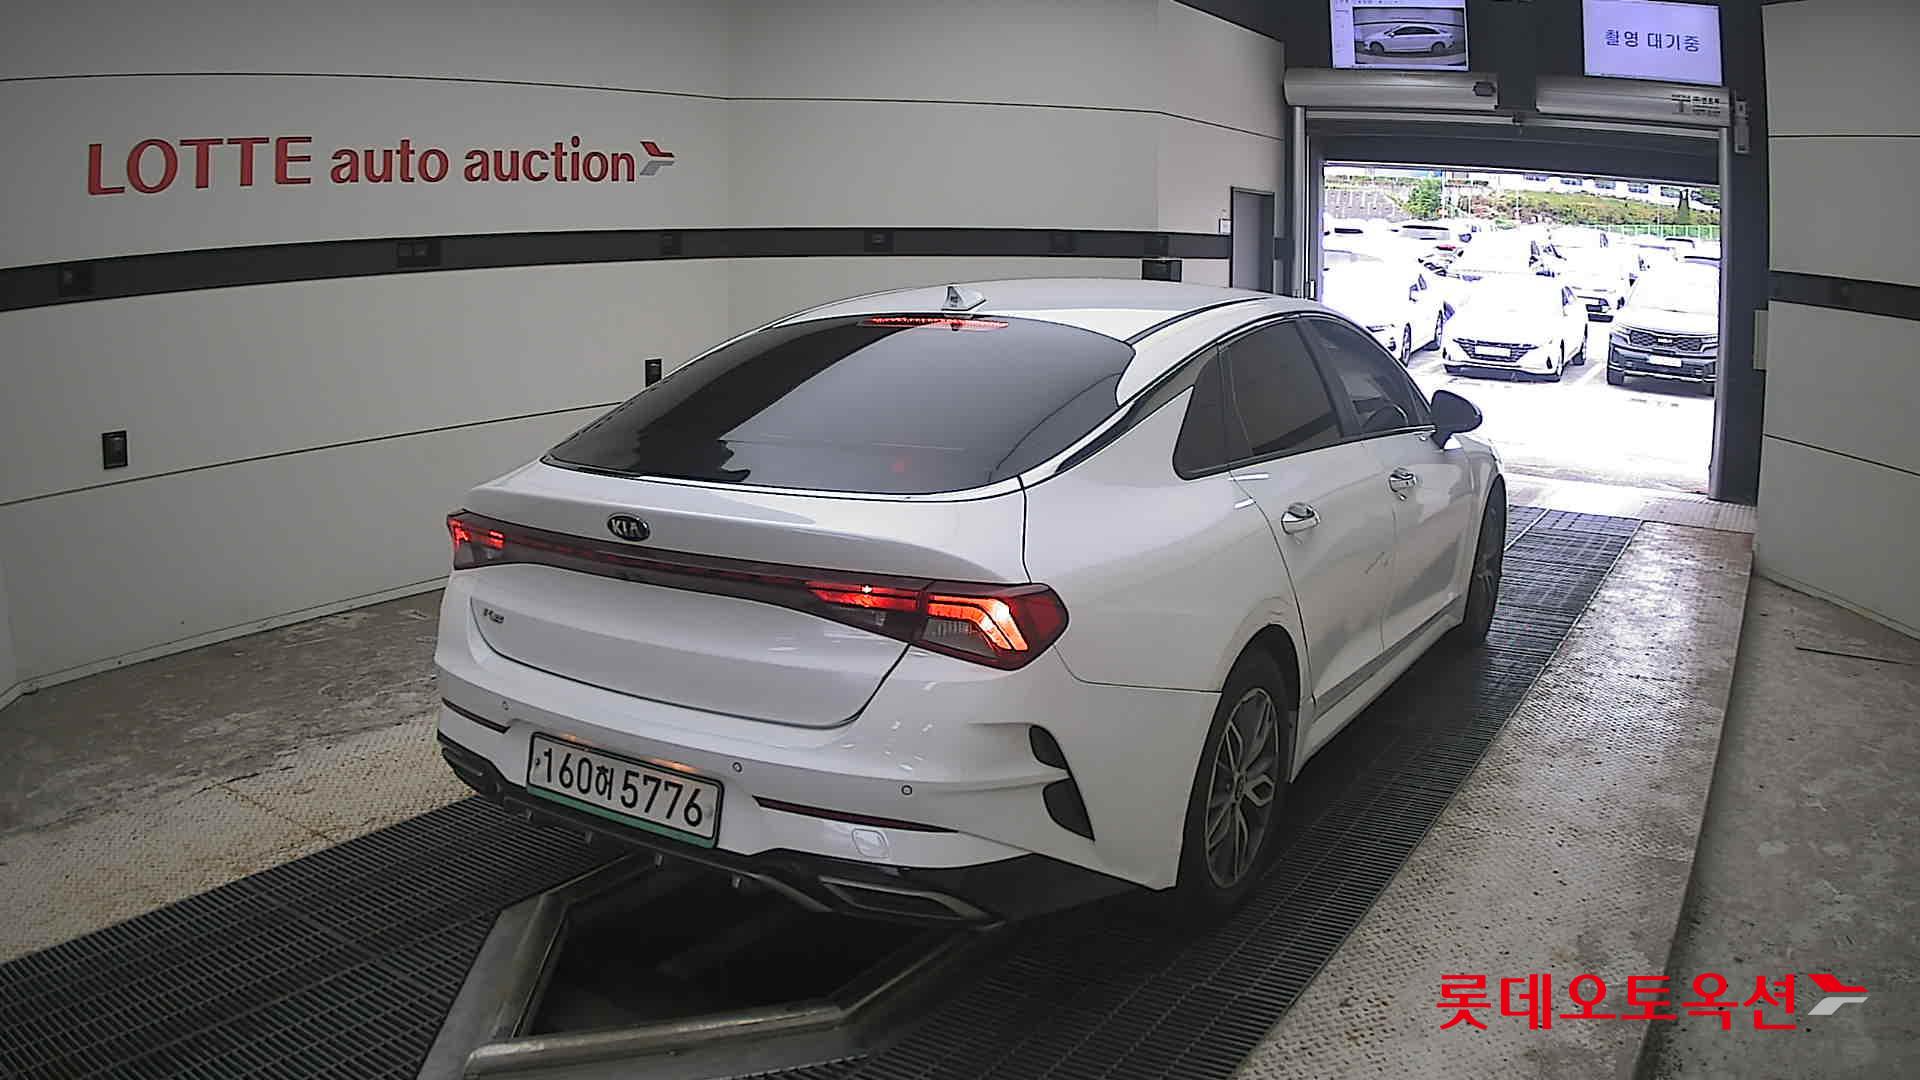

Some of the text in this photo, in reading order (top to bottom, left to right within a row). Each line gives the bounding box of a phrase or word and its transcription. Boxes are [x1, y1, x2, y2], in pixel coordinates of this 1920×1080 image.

[1647, 32, 1702, 52] 대기중
[87, 134, 636, 196] LOTTE auto auction
[611, 519, 641, 536] KIA
